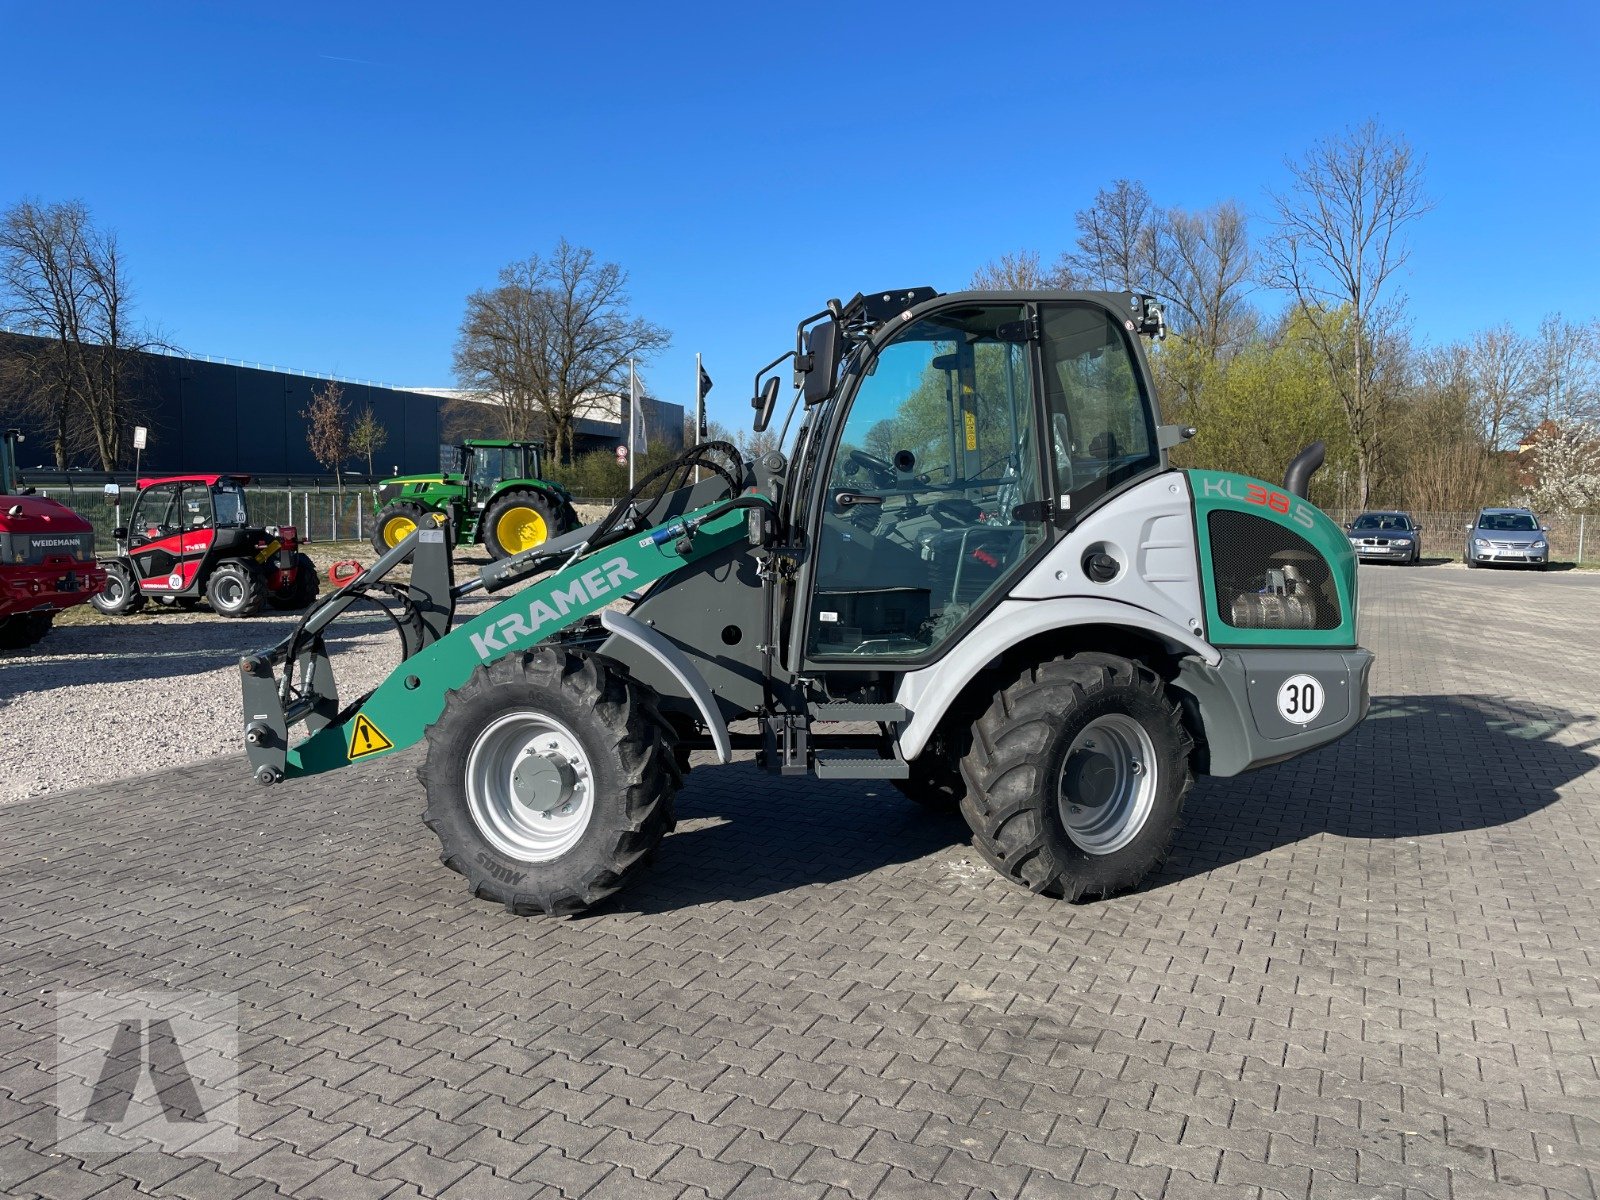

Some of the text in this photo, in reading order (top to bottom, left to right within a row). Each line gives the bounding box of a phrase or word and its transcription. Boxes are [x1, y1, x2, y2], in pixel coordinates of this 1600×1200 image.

[1203, 478, 1314, 529] KL38.5
[31, 538, 81, 548] WEIDEMANN
[171, 577, 180, 587] 20
[469, 556, 639, 660] KRAMER
[1286, 683, 1315, 714] 30
